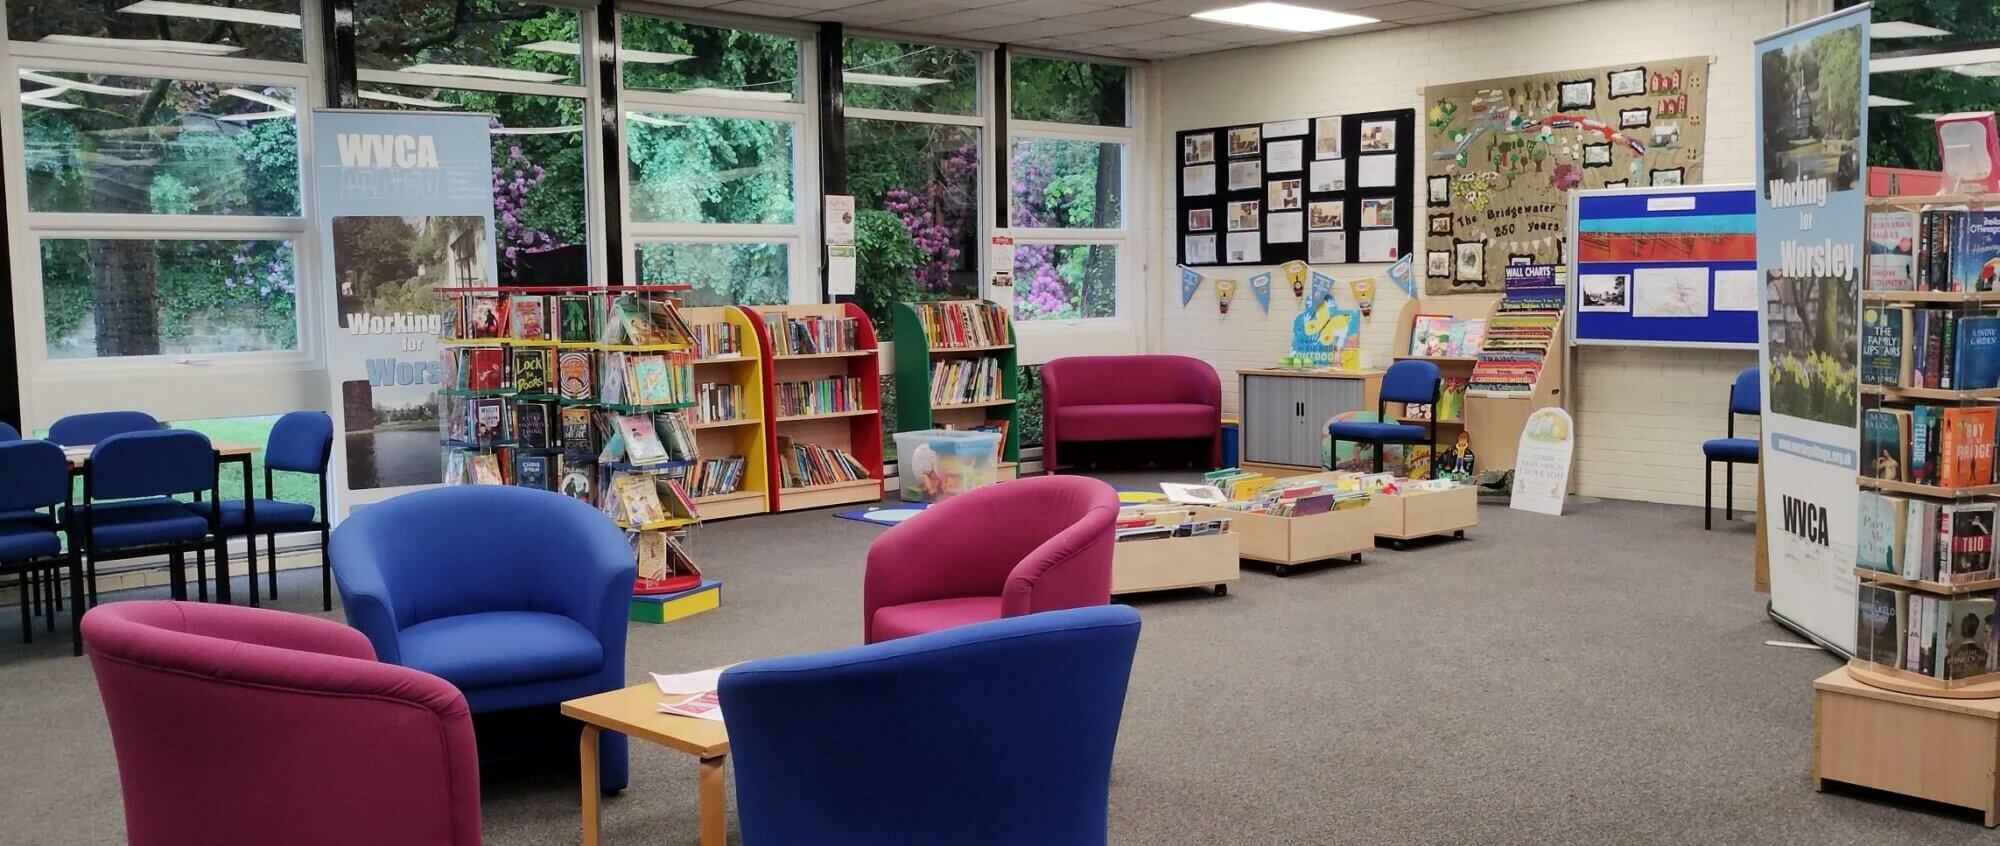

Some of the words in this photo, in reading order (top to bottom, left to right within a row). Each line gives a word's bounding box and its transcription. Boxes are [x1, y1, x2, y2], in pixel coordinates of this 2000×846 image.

[336, 133, 439, 168] WVCA
[1769, 174, 1827, 209] Working
[1457, 215, 1477, 227] The
[1487, 204, 1556, 220] Bridgewater
[1800, 211, 1813, 231] for
[1494, 224, 1515, 237] 250
[1528, 221, 1559, 232] years
[1780, 238, 1854, 282] Worsley
[1505, 268, 1523, 277] WALL
[1525, 266, 1551, 276] CHARTS
[1872, 279, 1907, 287] COUNTRY
[346, 312, 441, 335] Working
[1874, 326, 1892, 336] THE
[402, 336, 424, 352] for
[1868, 335, 1897, 346] FAMILY
[1863, 346, 1900, 356] UPSAIRS
[365, 358, 441, 387] Wors
[516, 357, 542, 375] Lock
[517, 378, 543, 398] Doors
[1966, 424, 1985, 437] BOY
[1914, 423, 1926, 463] FELLSIDE
[1957, 444, 1991, 459] BRIDGE
[1783, 495, 1829, 546] WVCA
[1963, 537, 1984, 552] TRIO
